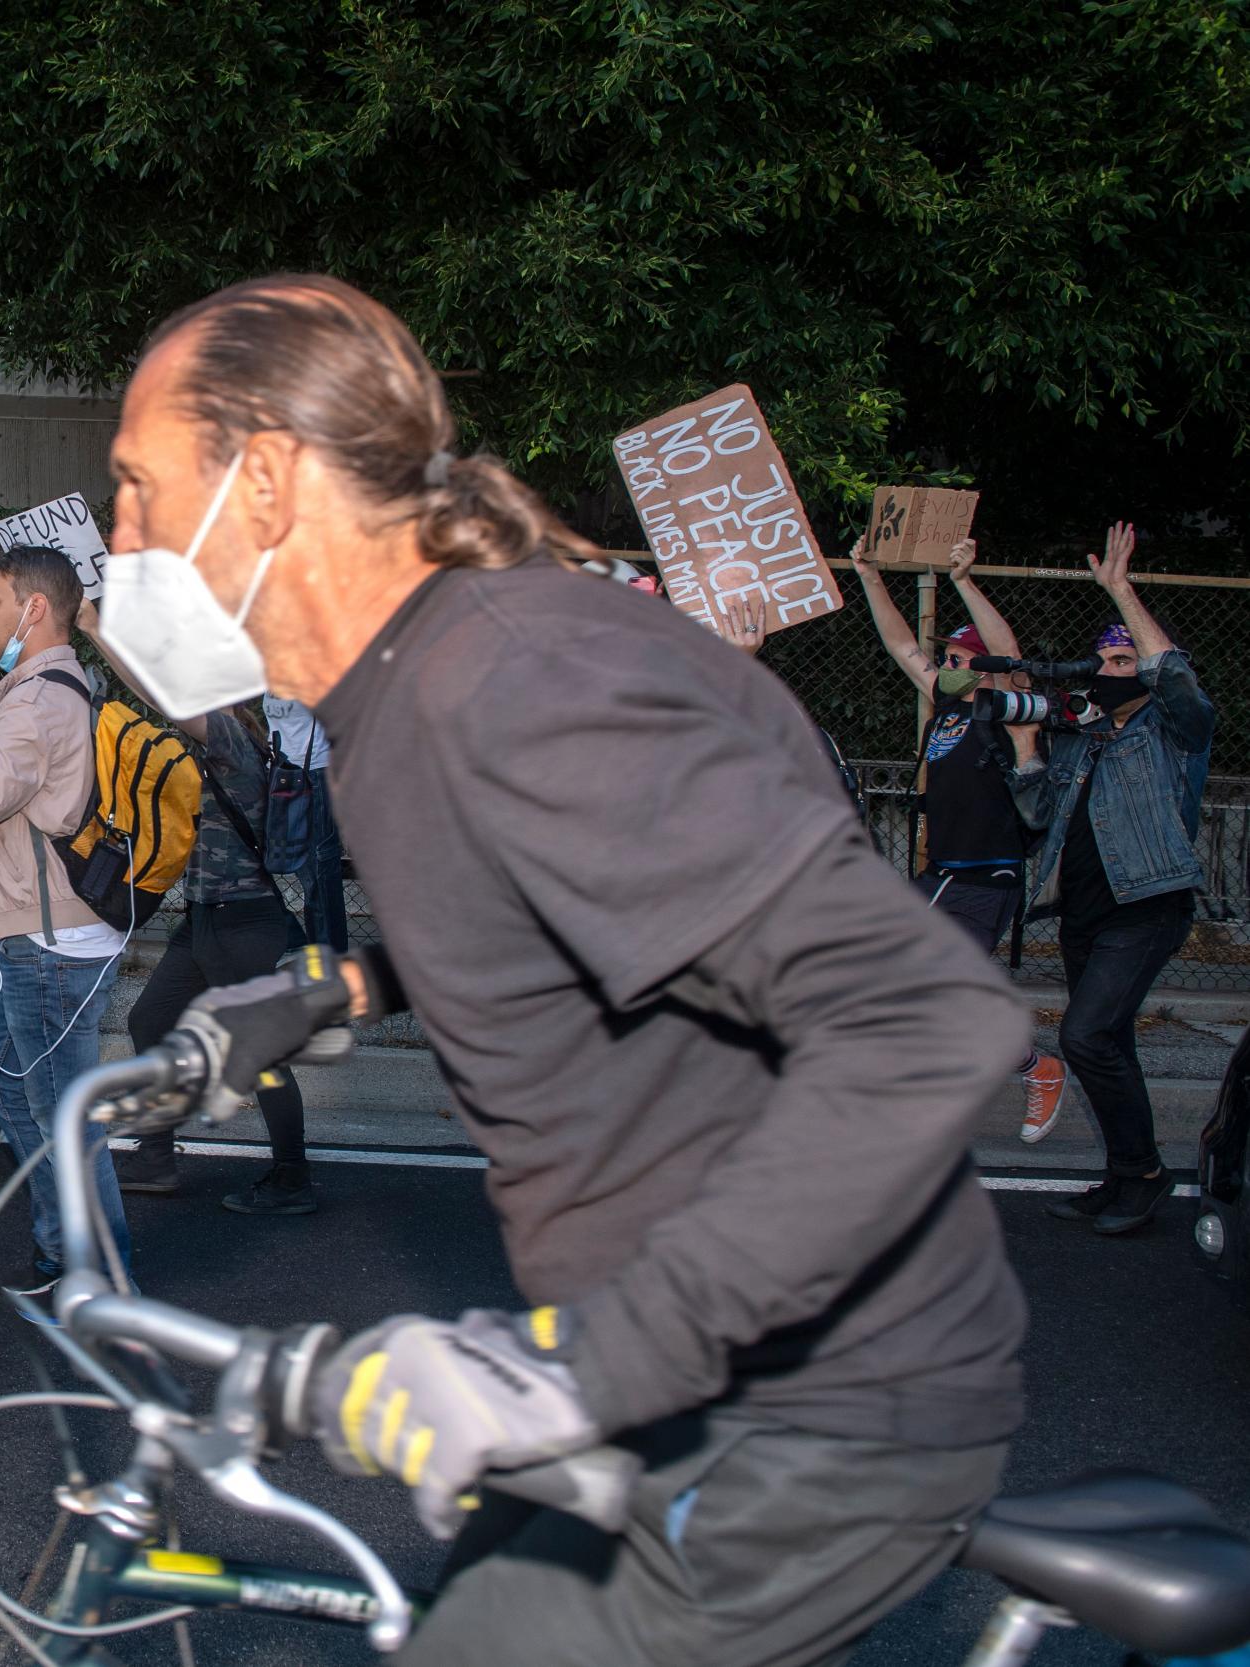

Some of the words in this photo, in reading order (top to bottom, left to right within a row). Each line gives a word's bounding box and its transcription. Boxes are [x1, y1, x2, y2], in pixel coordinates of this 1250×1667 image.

[614, 430, 667, 502] BLACK
[650, 417, 712, 476] NO
[640, 500, 688, 561] LIVES
[701, 398, 761, 456] NO
[731, 463, 835, 624] JUSTICE
[678, 485, 770, 615] PEACE
[663, 560, 722, 638] MATTE
